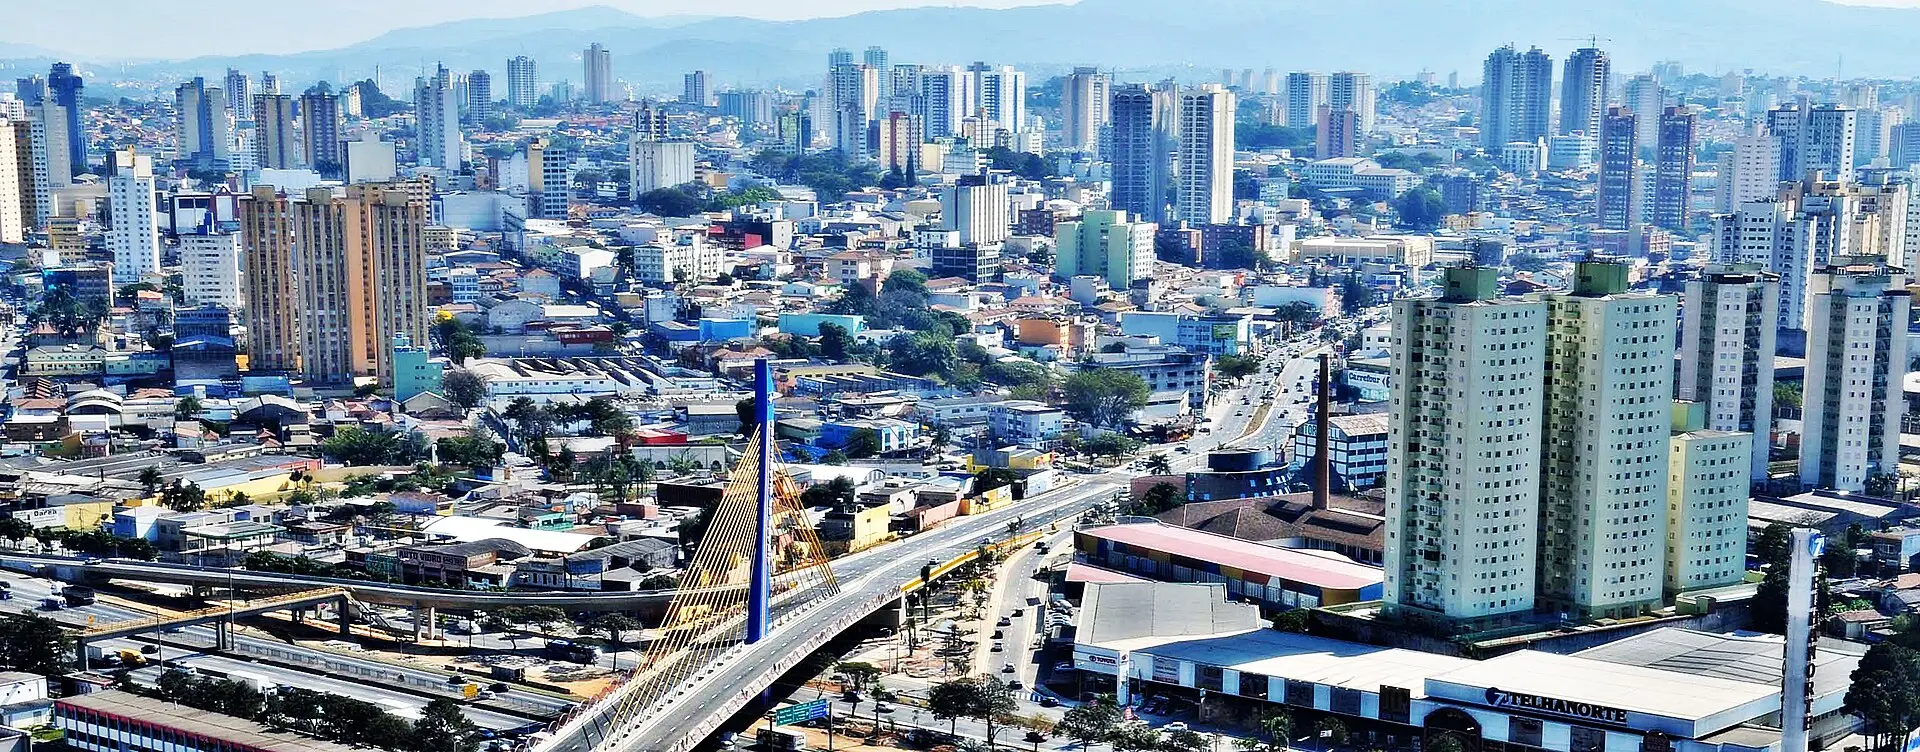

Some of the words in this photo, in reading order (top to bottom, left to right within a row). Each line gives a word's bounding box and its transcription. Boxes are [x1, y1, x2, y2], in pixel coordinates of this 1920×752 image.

[1349, 372, 1381, 384] Carrefour
[1097, 656, 1116, 665] TOYOTA
[1510, 692, 1627, 720] TELHANORTE
